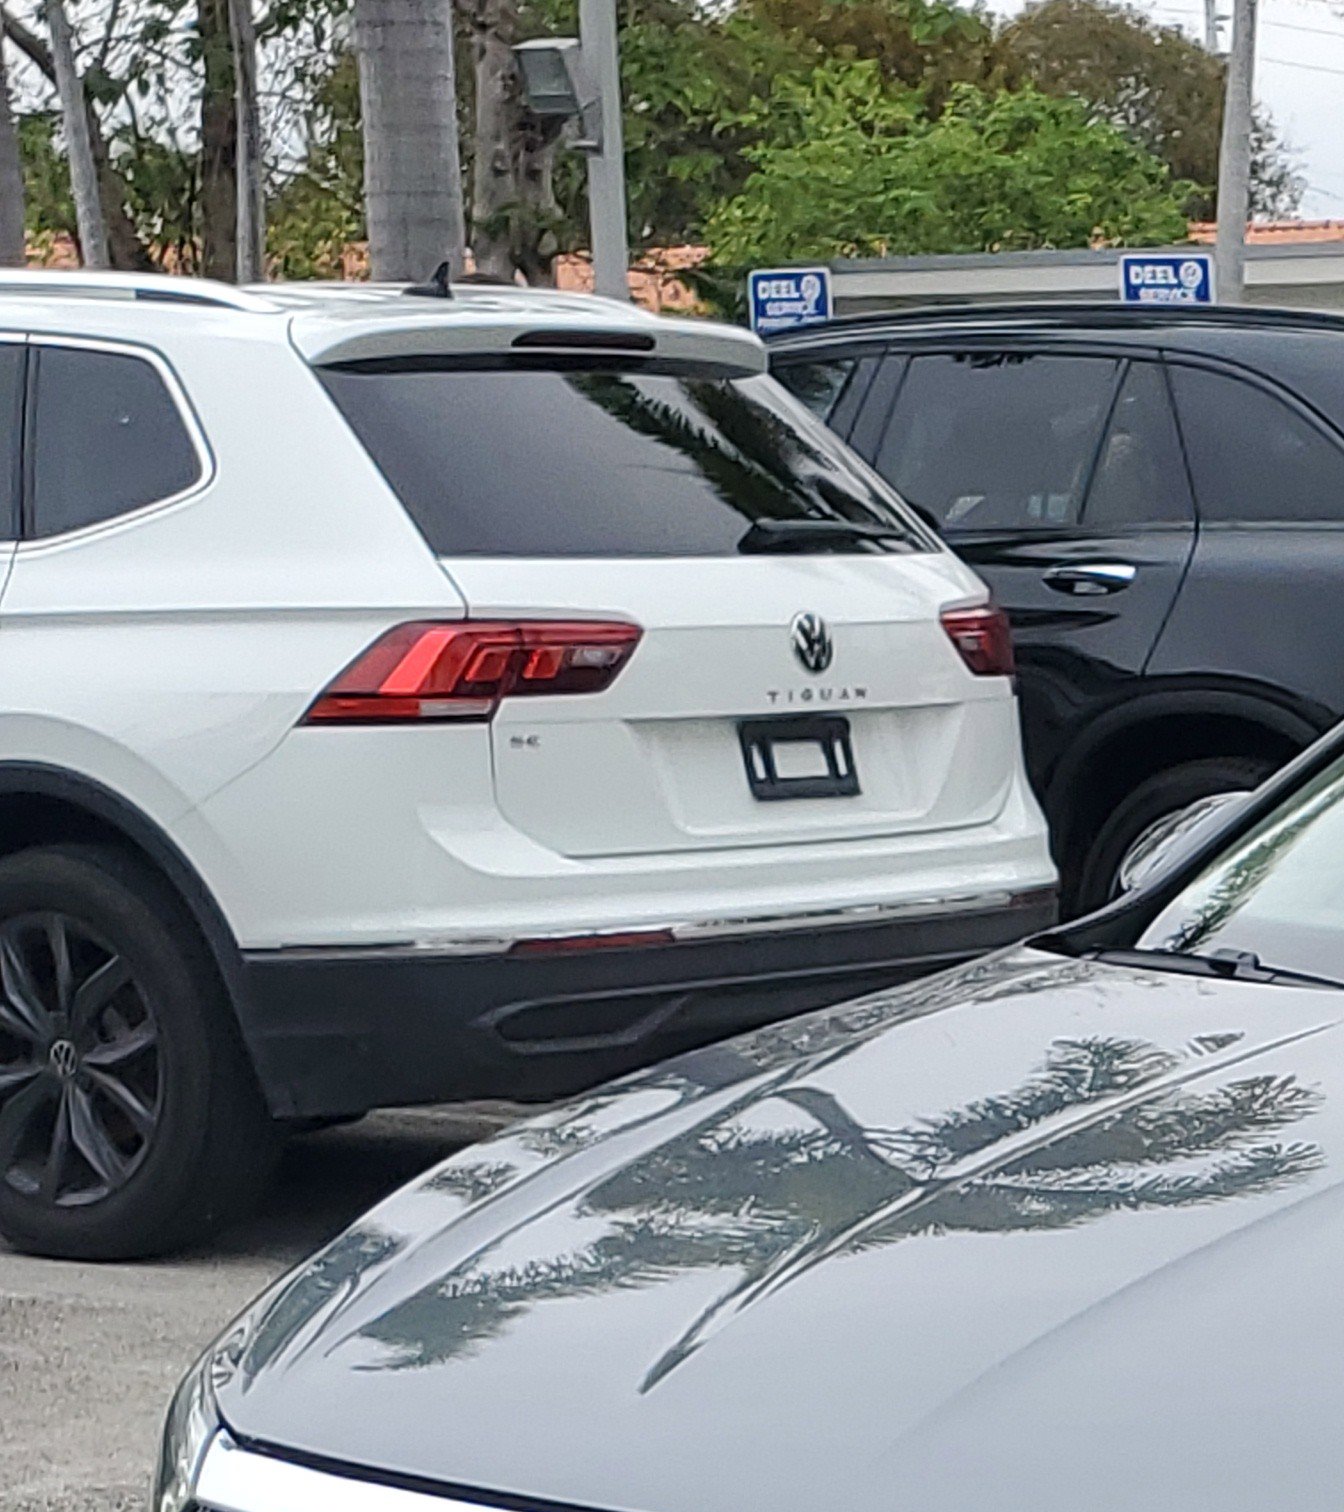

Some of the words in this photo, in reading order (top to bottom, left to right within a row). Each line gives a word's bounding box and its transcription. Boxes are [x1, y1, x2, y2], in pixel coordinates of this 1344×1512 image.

[1129, 265, 1178, 285] DEEL
[758, 280, 800, 299] DEEL
[766, 687, 869, 704] TIGUAN
